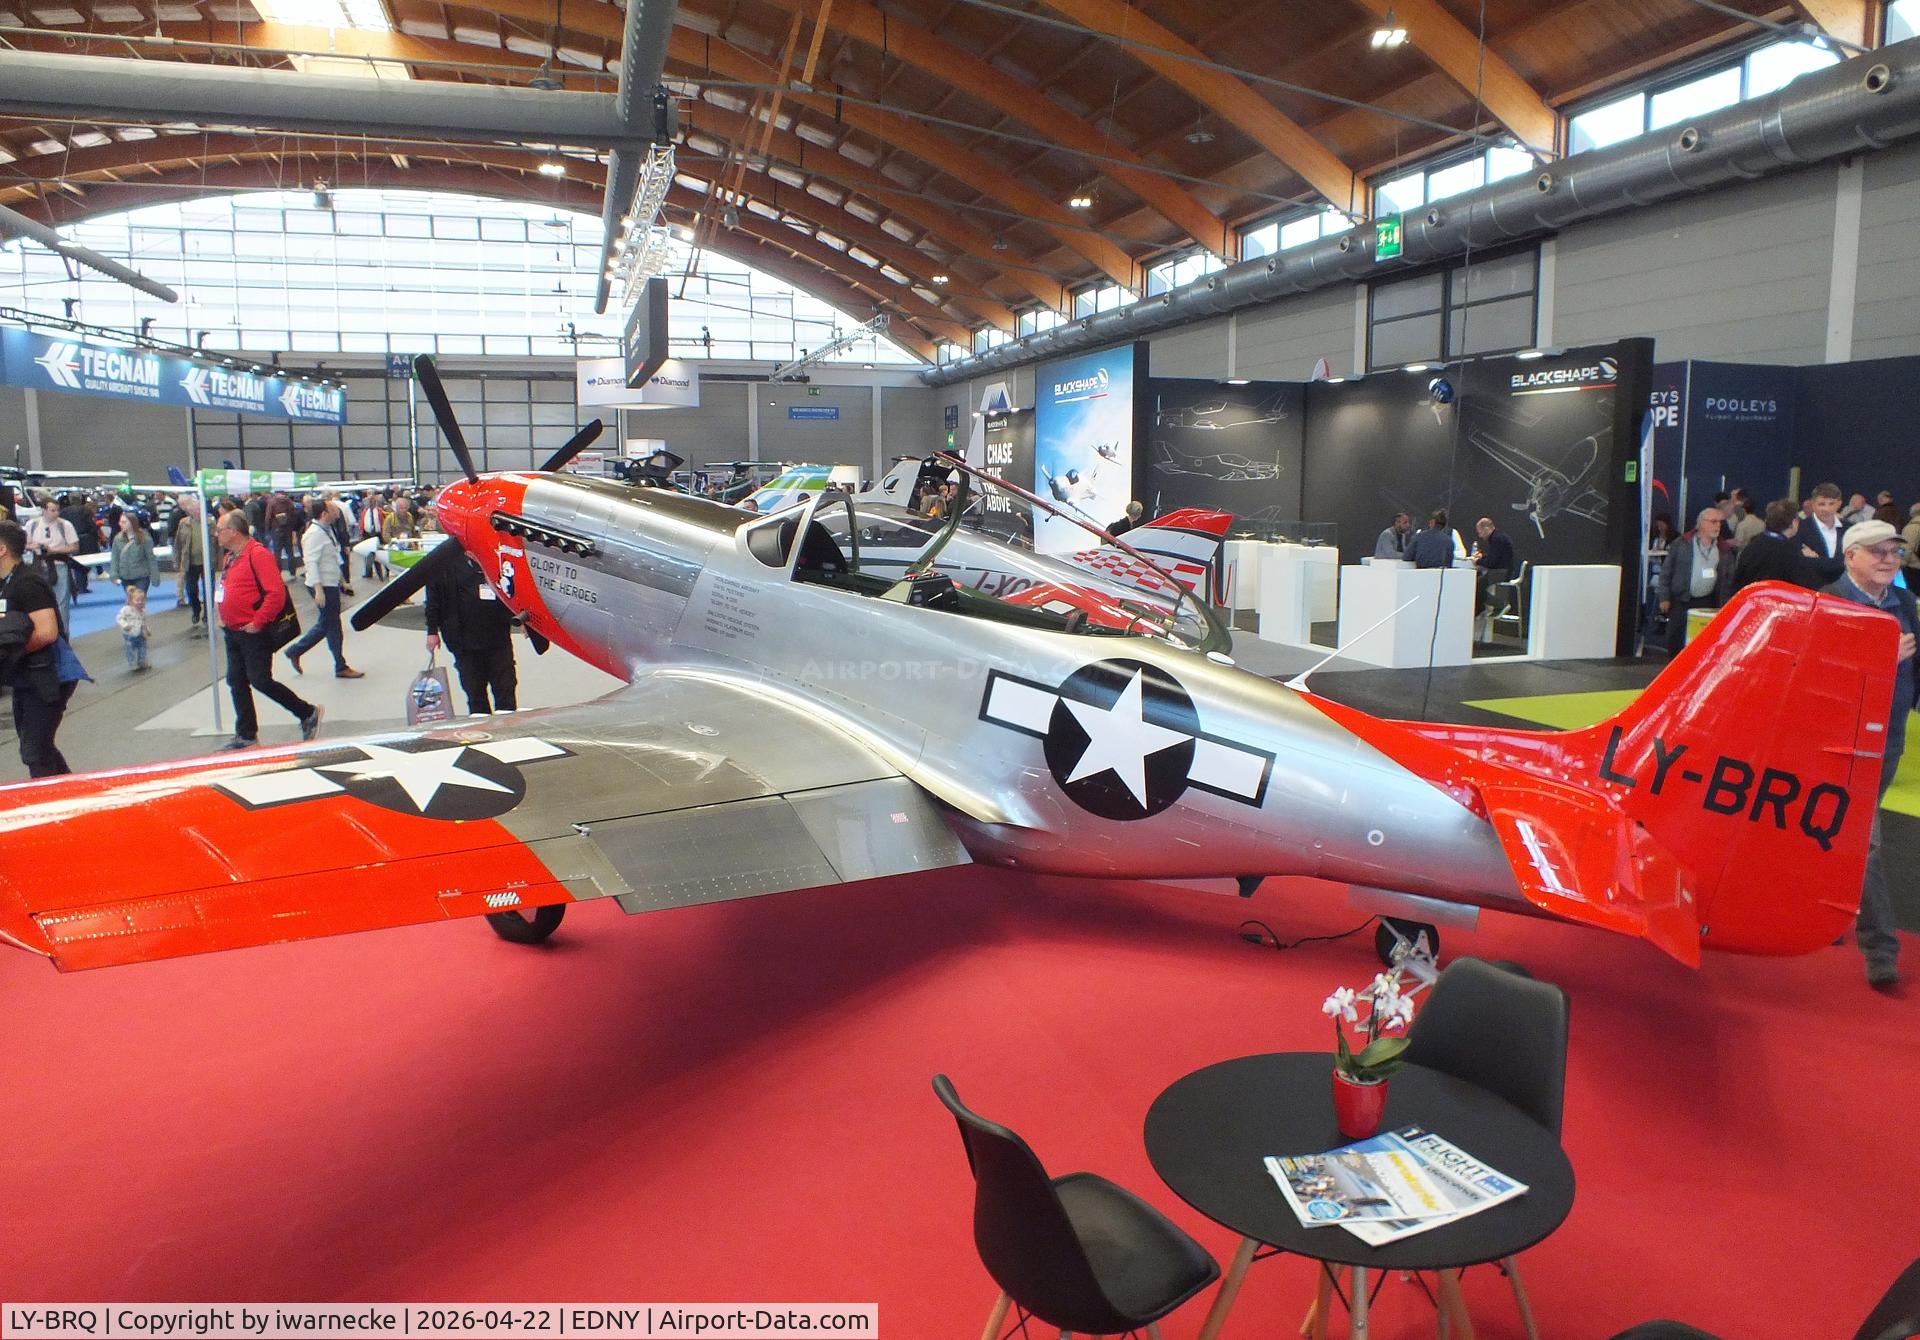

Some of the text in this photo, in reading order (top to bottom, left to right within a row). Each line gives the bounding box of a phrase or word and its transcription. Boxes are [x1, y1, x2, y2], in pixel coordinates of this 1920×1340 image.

[80, 347, 160, 386] TECNAM
[1511, 366, 1599, 388] BLACKSHAPE
[210, 371, 265, 402] TECNAM
[597, 377, 627, 386] Diamon
[660, 376, 690, 387] Diamond
[1054, 376, 1099, 396] BLACKSHAPE
[301, 388, 340, 413] TECNAM
[1650, 391, 1679, 404] EYS
[1706, 397, 1777, 412] POOLEYS
[987, 442, 1013, 465] CHASE
[986, 494, 1012, 513] ABOVE
[530, 556, 577, 580] GLORY TO
[538, 575, 598, 604] THE HEROES
[1600, 725, 1850, 852] LY-BRQ
[1420, 1137, 1486, 1175] FLIGHT
